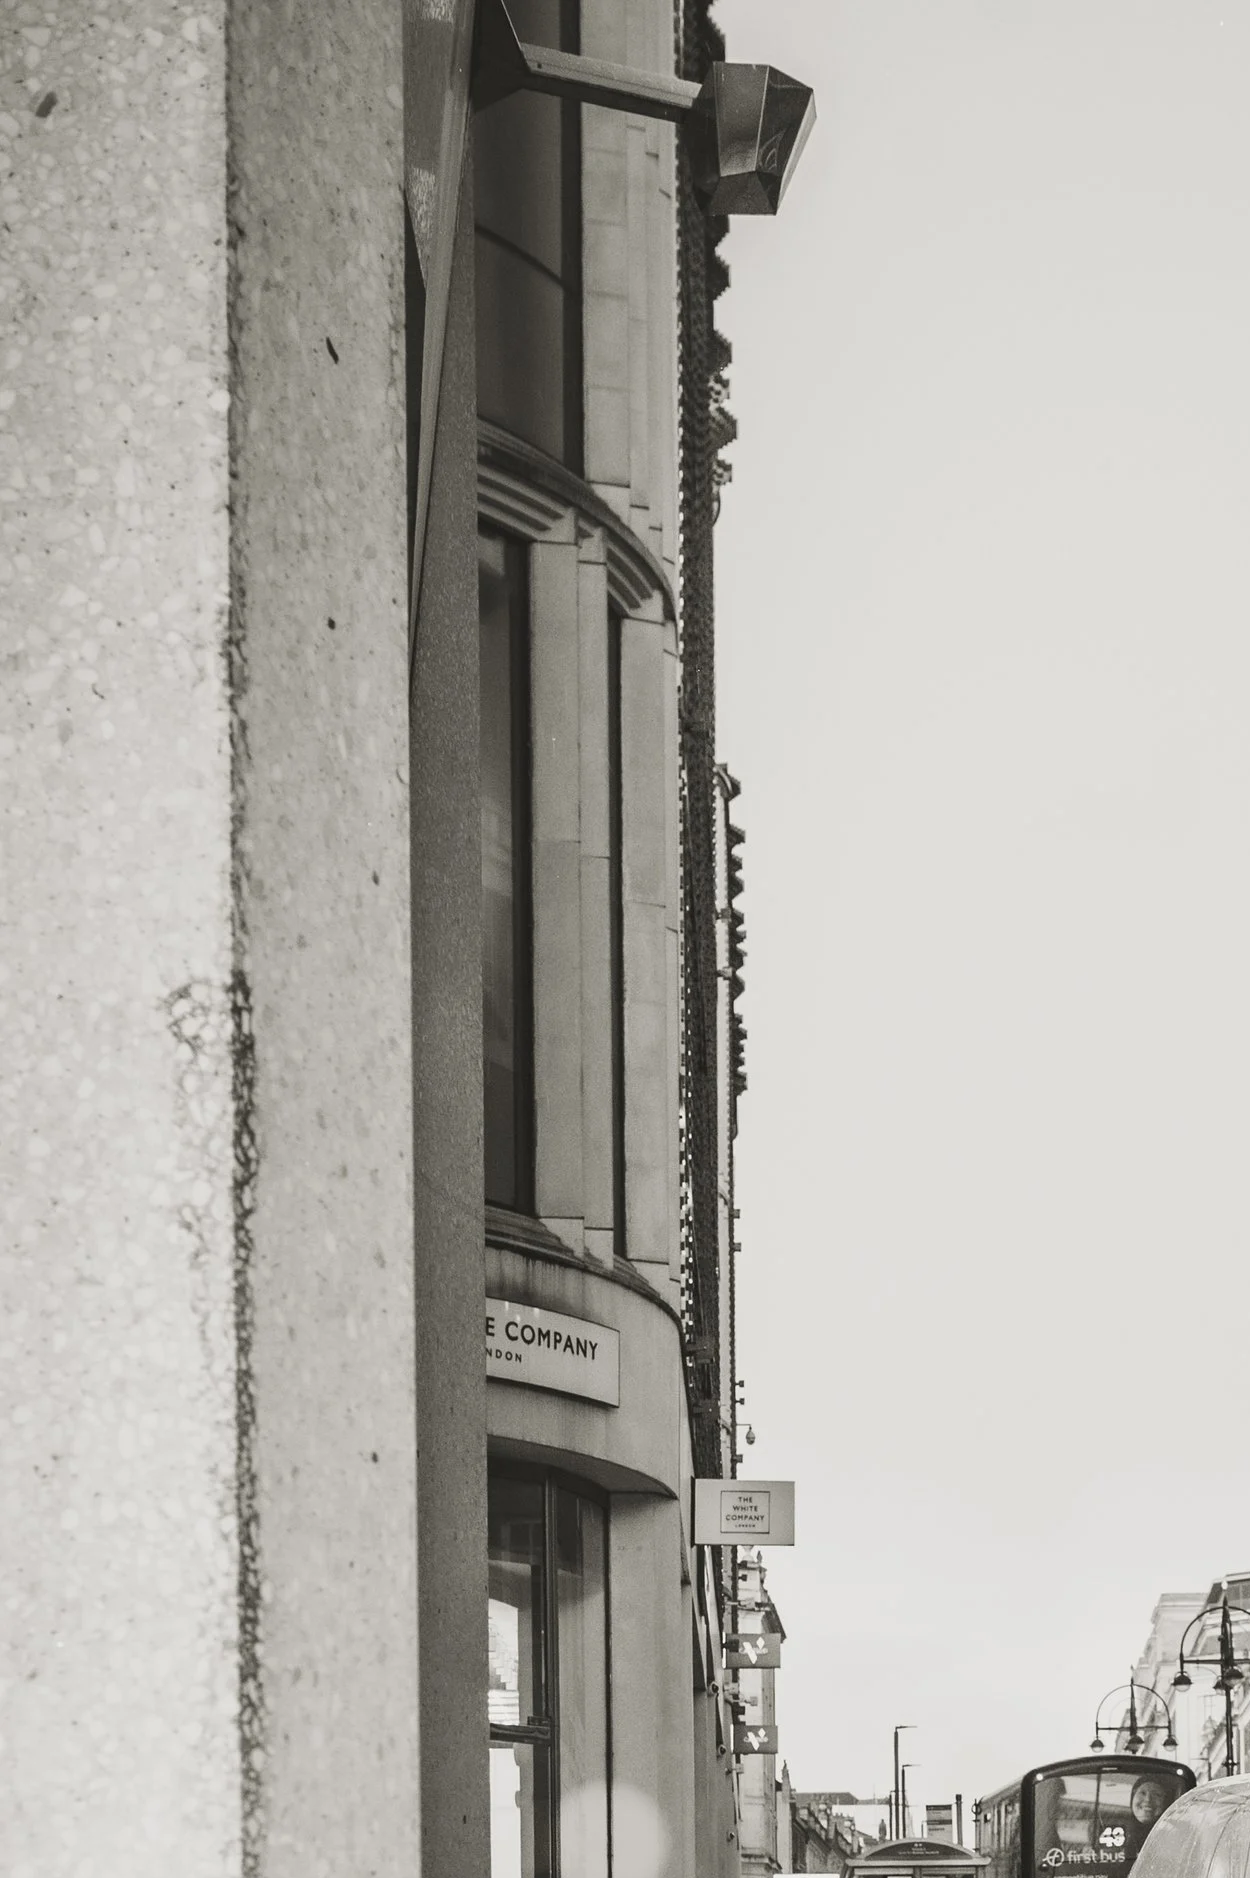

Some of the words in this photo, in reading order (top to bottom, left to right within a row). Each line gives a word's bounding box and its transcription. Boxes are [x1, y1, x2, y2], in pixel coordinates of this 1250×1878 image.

[505, 1321, 598, 1360] COMPANY
[738, 1496, 753, 1504] THE
[725, 1514, 765, 1522] COMPANY
[1067, 1850, 1098, 1864] first
[1100, 1849, 1126, 1863] bus
